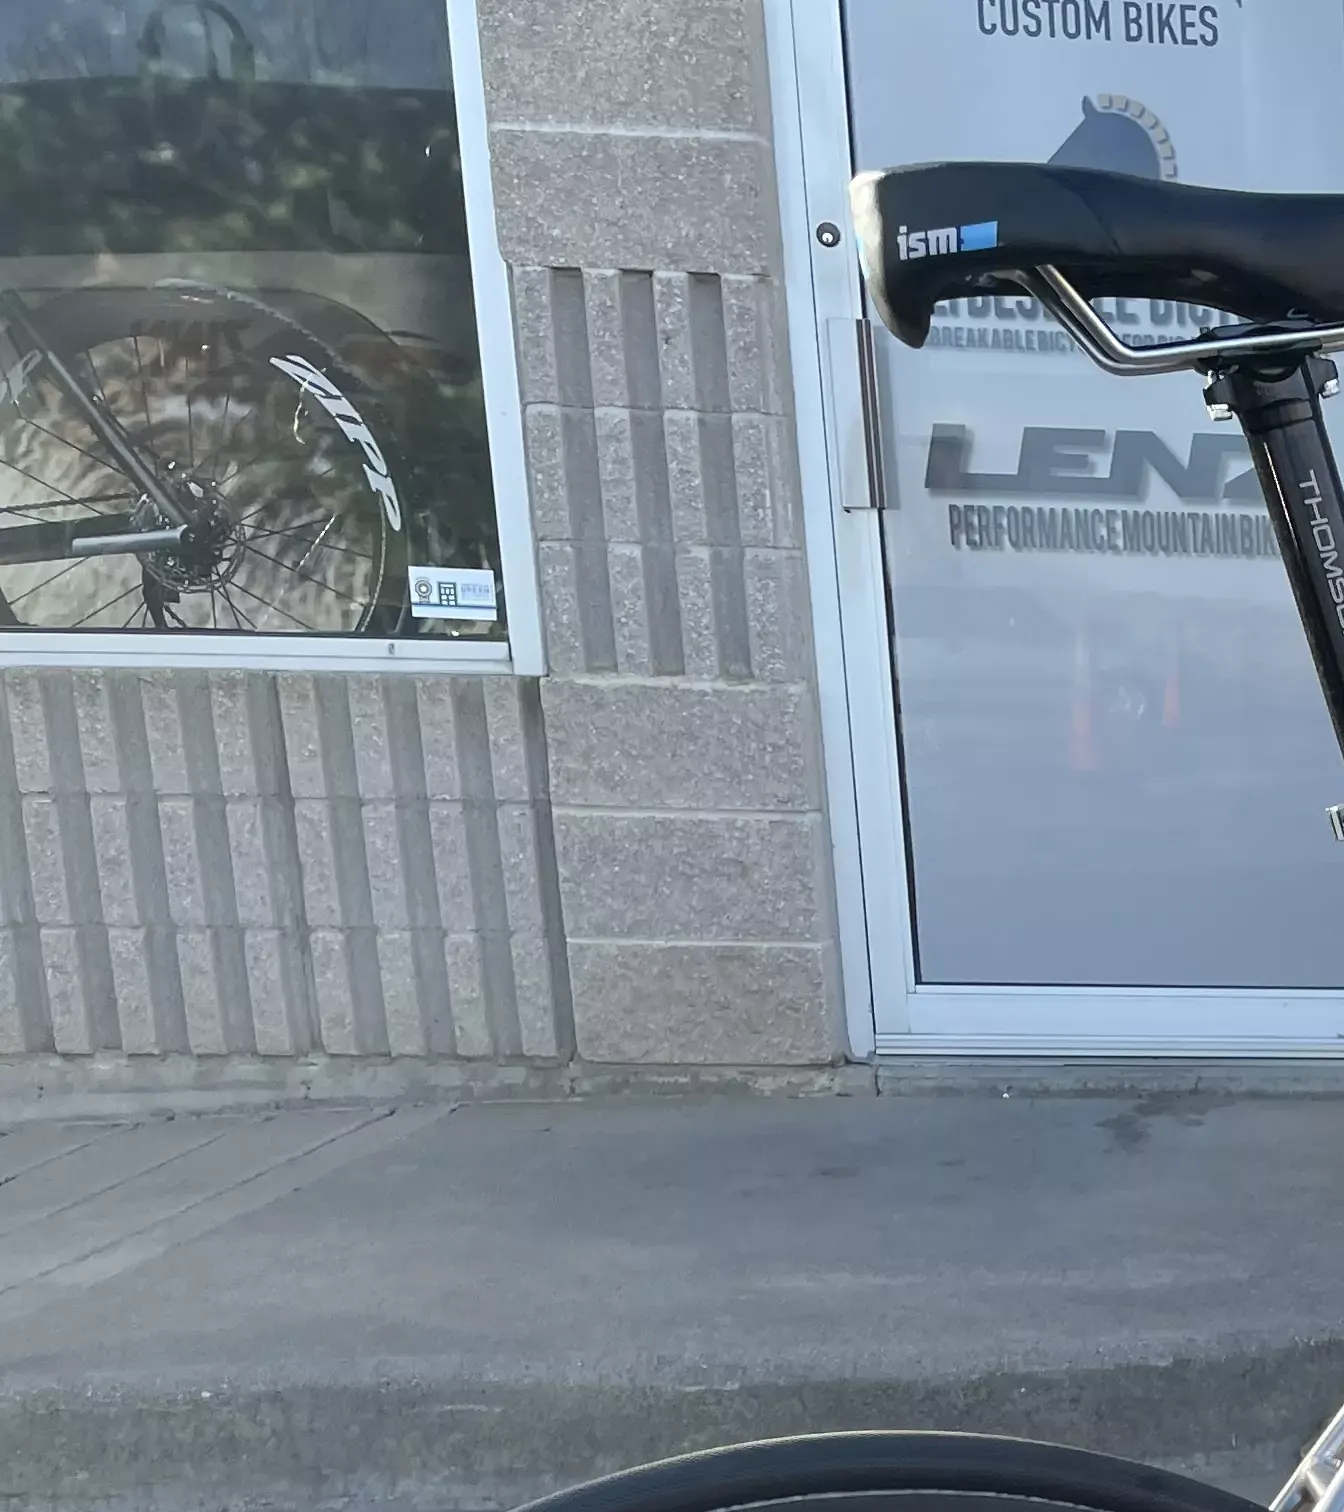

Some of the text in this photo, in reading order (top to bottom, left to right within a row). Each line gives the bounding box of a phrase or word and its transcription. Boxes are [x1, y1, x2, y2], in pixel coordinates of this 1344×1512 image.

[977, 0, 1218, 47] CUSTOM BIKES
[896, 225, 958, 261] ism
[269, 354, 402, 532] ZIPP
[949, 503, 1281, 559] PERFORMANCE MOUNTAIN BIK
